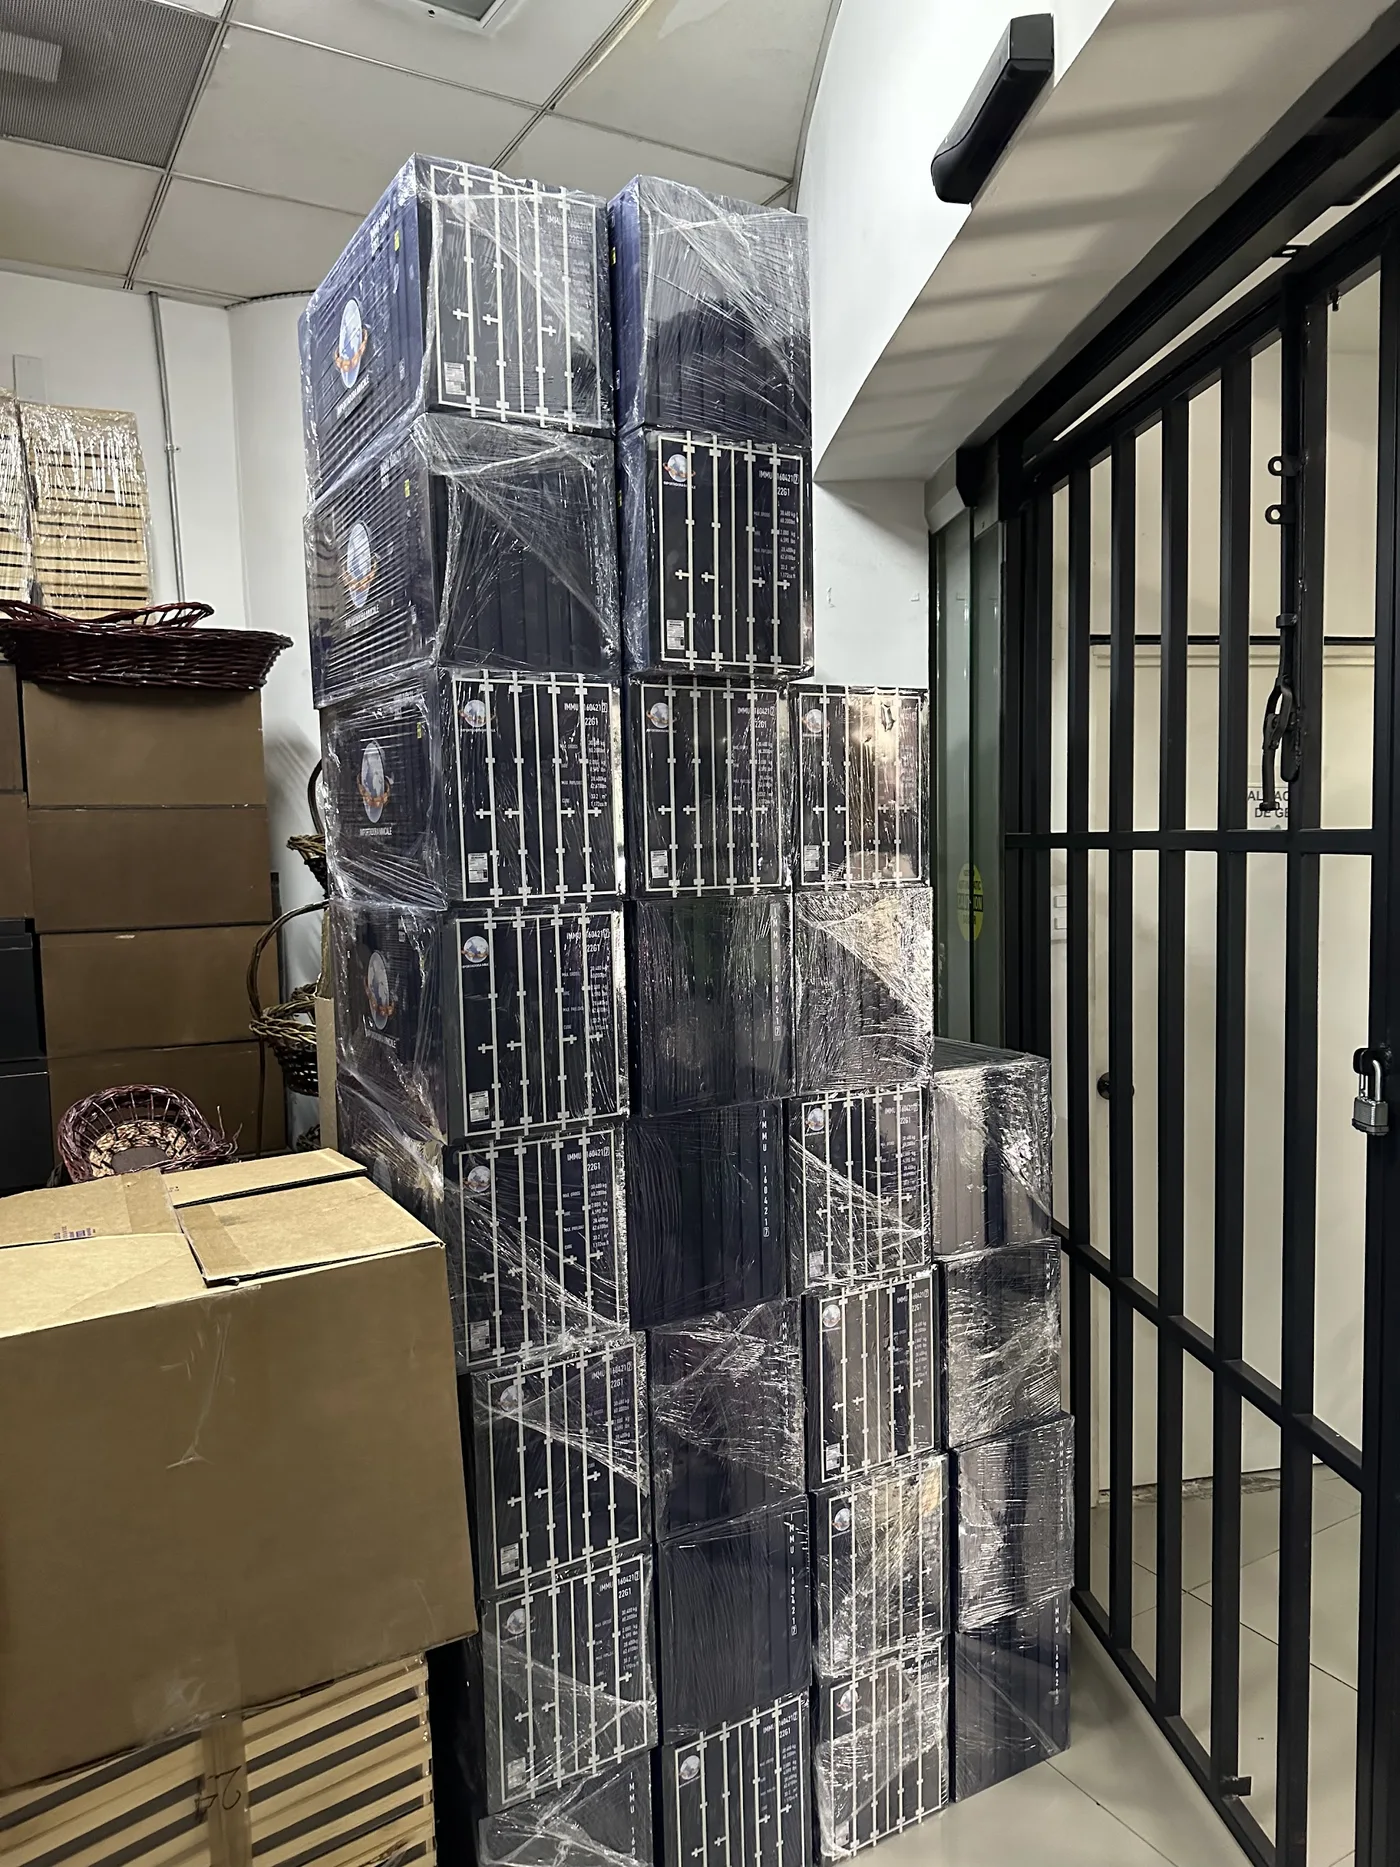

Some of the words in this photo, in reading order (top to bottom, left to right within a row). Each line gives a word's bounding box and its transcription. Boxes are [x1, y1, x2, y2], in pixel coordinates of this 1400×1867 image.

[759, 470, 772, 480] IMMU
[777, 487, 790, 496] 22G1
[564, 703, 579, 711] IMMU
[586, 702, 608, 713] 604217
[585, 717, 598, 726] 22G1
[1254, 808, 1271, 818] DE
[587, 944, 600, 952] 22G1
[567, 1152, 581, 1161] IMMU
[587, 1162, 600, 1171] 22G1
[611, 1378, 623, 1389] 22G1
[618, 1570, 640, 1586] 1604217
[618, 1587, 631, 1599] 22G1
[779, 1727, 791, 1738] 22G1
